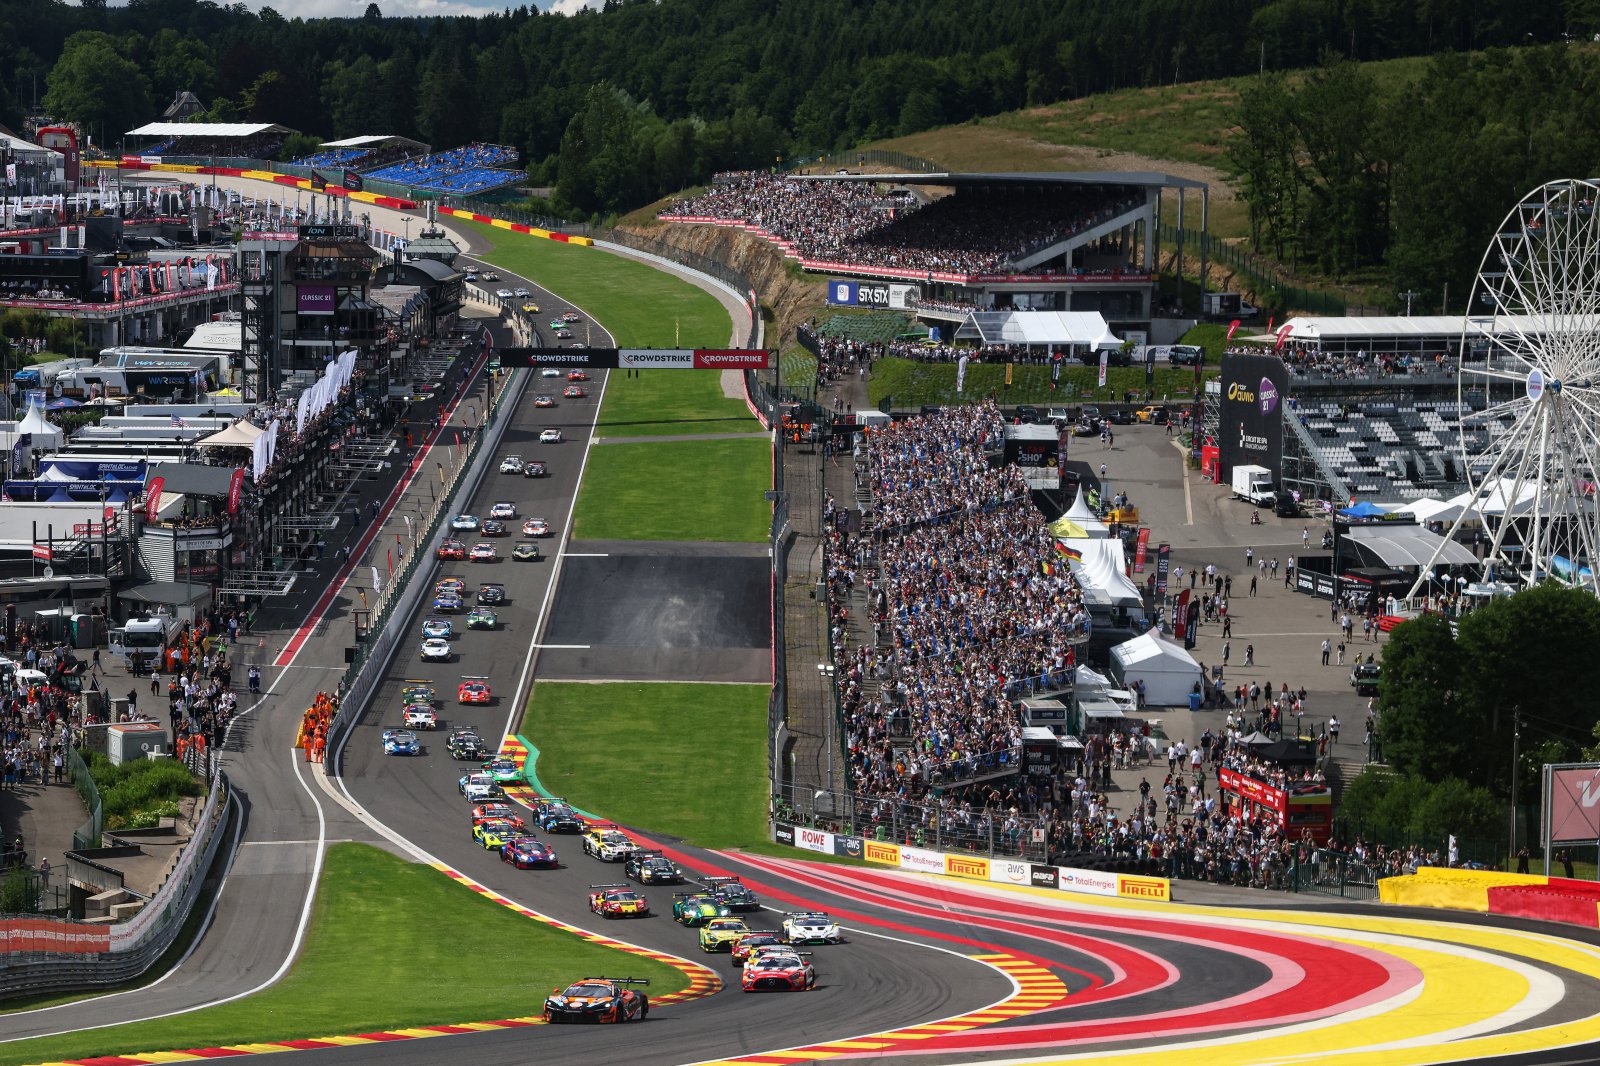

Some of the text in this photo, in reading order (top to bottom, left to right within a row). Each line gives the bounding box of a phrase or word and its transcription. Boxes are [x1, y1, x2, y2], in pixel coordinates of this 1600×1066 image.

[859, 288, 873, 302] STX
[874, 289, 889, 303] STX
[531, 354, 589, 362] CROWDSTRIKE
[628, 354, 692, 362] CROWDSTRIKE
[704, 354, 763, 362] CROWDSTRIKE
[802, 831, 825, 846] ROWE
[847, 838, 860, 850] aws
[867, 844, 898, 862] PIRELLI
[911, 855, 944, 868] TotalEnergies
[948, 858, 987, 876] PIRELLI
[1007, 863, 1025, 875] aws
[1075, 877, 1115, 890] TotalEnergies
[1121, 879, 1164, 897] PIRELLI
